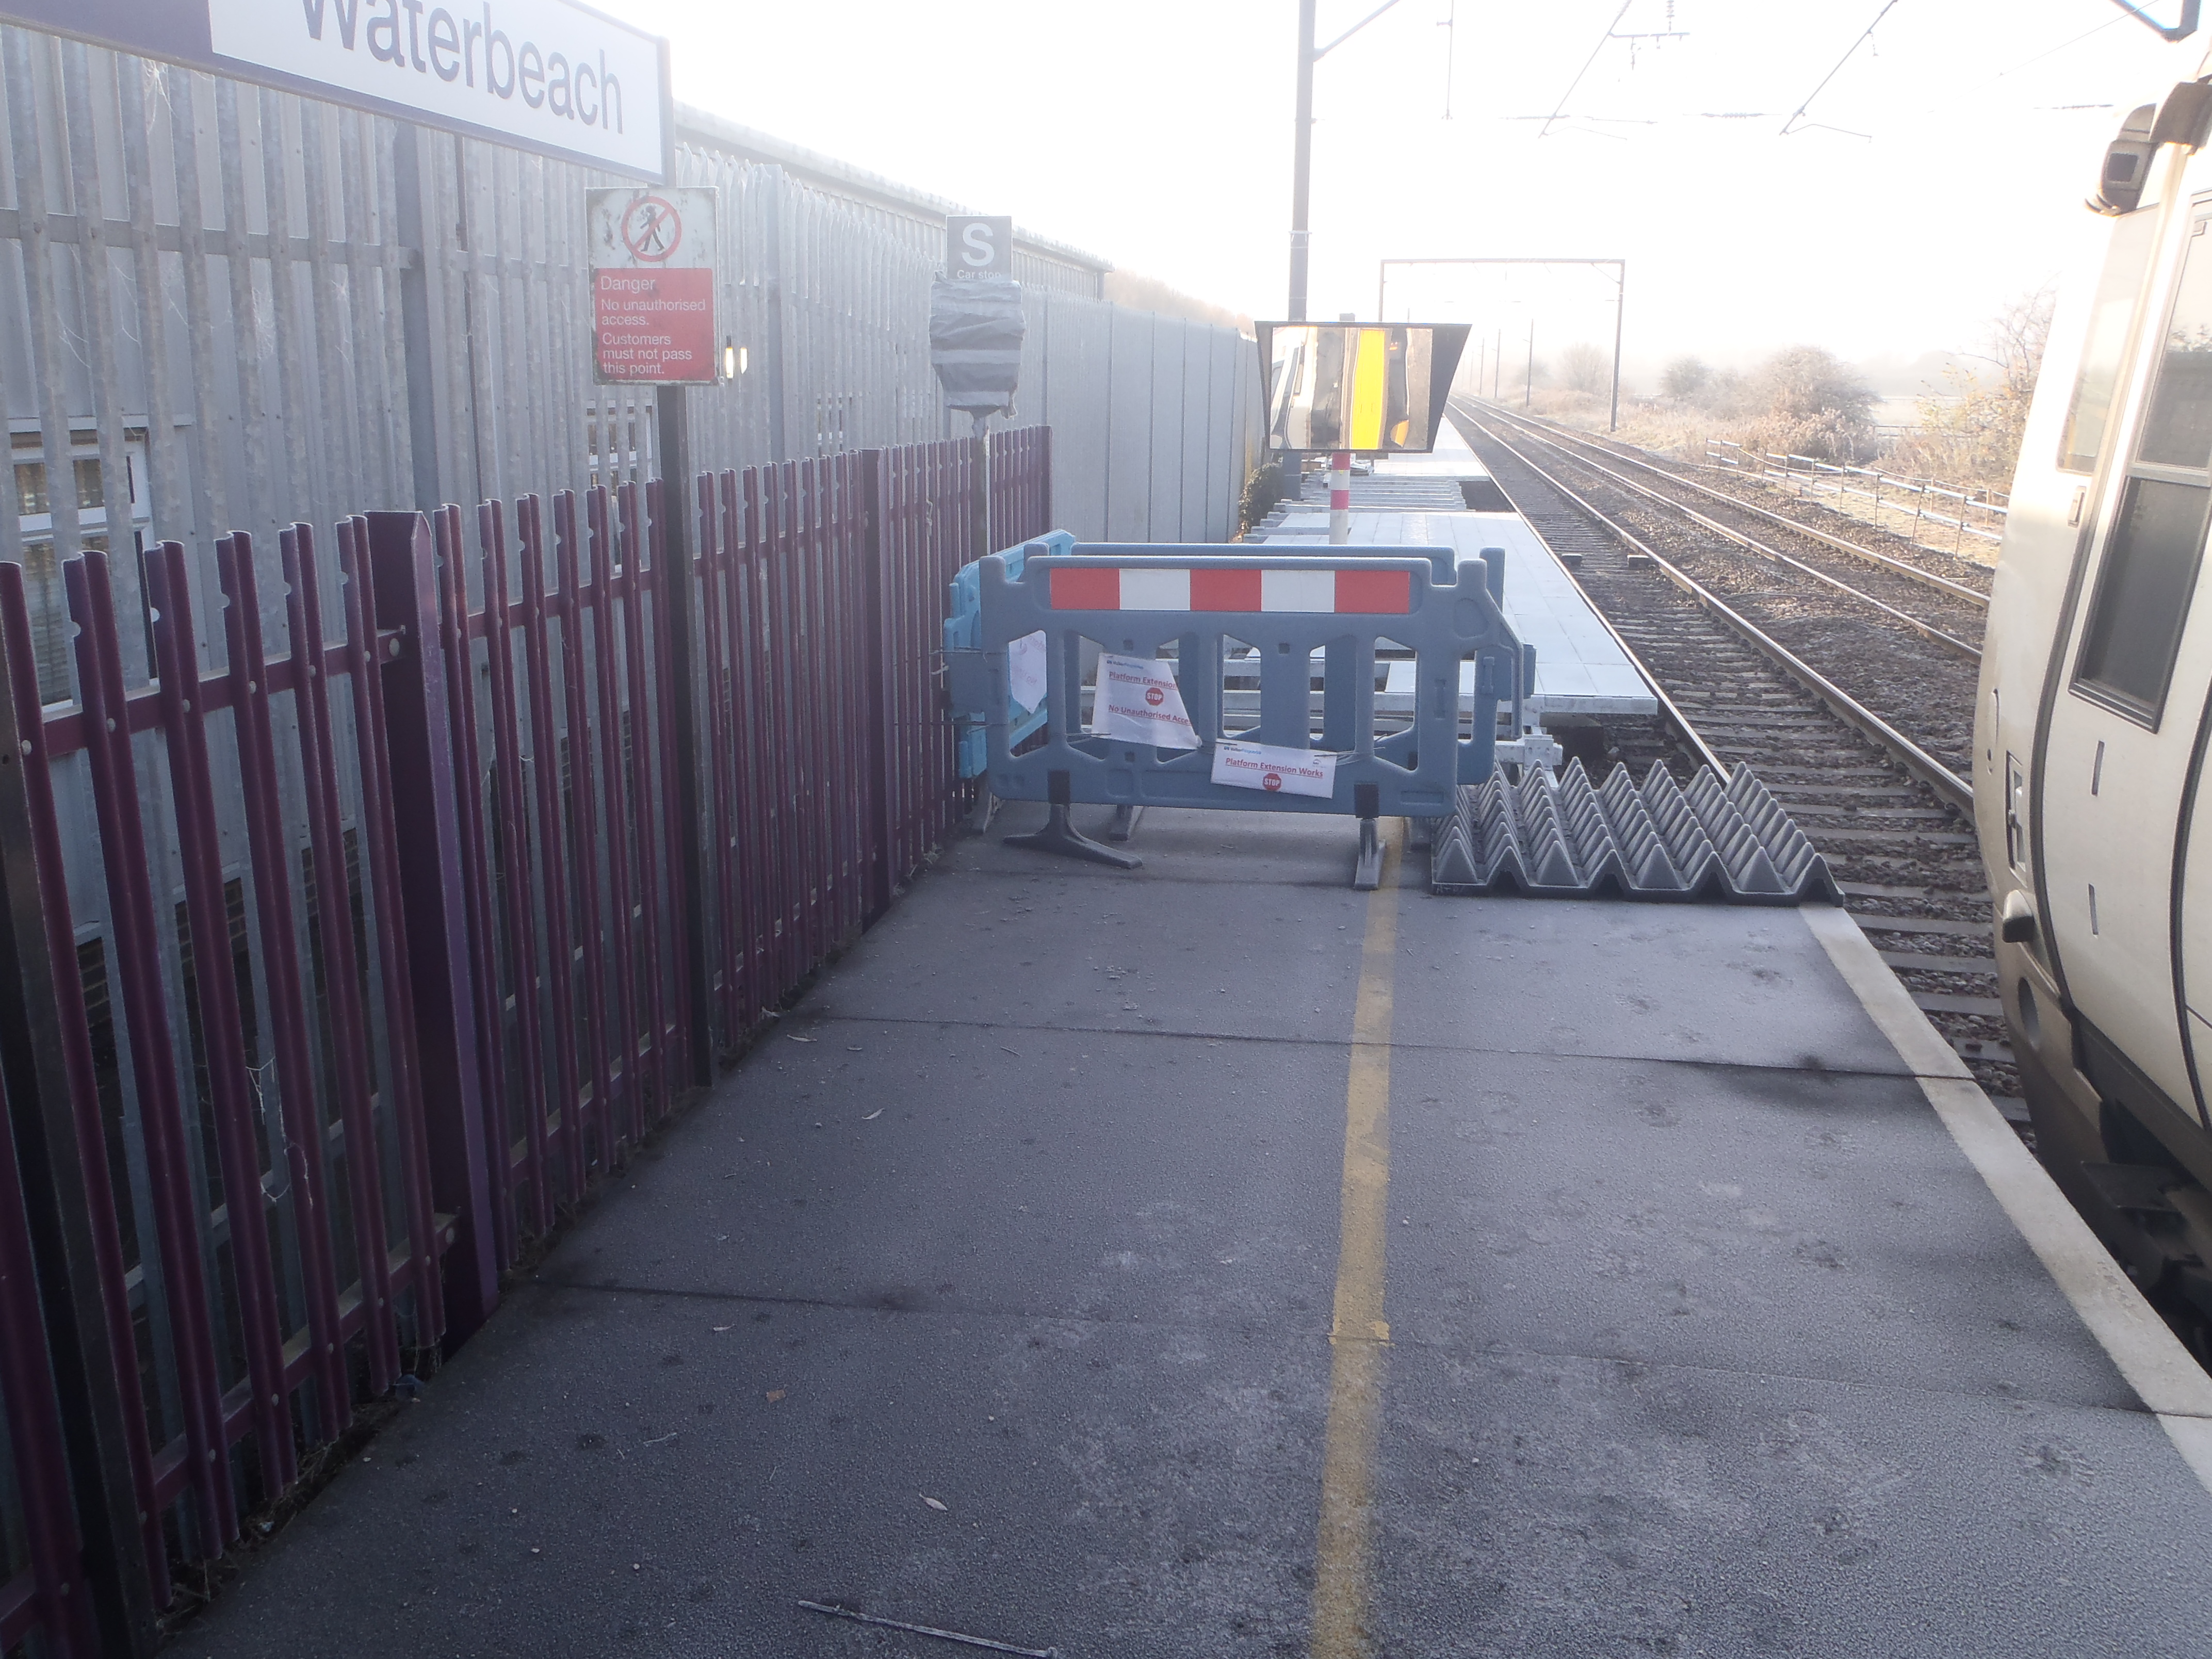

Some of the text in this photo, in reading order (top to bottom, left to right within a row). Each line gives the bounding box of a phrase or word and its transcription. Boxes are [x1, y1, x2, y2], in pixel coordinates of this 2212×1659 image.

[962, 222, 995, 267] S
[957, 270, 975, 279] Car
[600, 276, 655, 294] Danger
[601, 299, 705, 311] No unauthorised
[601, 316, 649, 326] access.
[603, 333, 671, 345] Customers
[603, 348, 692, 362] must not pass
[603, 362, 664, 376] this point.
[1109, 671, 1141, 683] Platform
[1146, 692, 1162, 701] STOP
[1109, 704, 1119, 712] No
[1121, 707, 1170, 720] Unauthorised
[1226, 757, 1323, 777] Platform Extension Works
